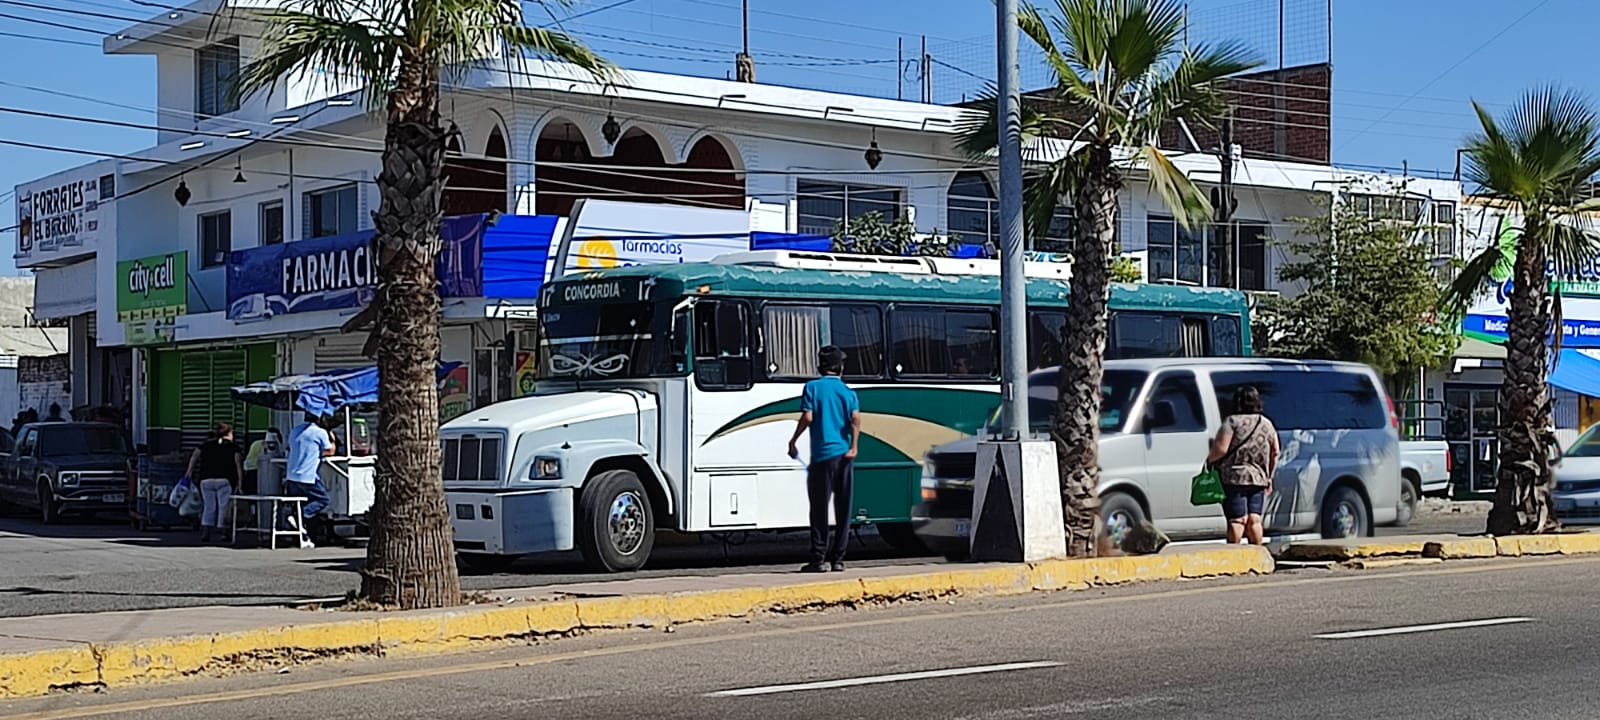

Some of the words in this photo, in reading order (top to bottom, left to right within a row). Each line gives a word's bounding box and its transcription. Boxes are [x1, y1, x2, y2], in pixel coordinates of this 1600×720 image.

[34, 220, 43, 242] EL
[621, 239, 682, 255] farmacias
[129, 261, 150, 297] city
[154, 257, 175, 288] cell
[281, 247, 377, 294] FARMACI
[564, 282, 620, 301] CONCORDIA
